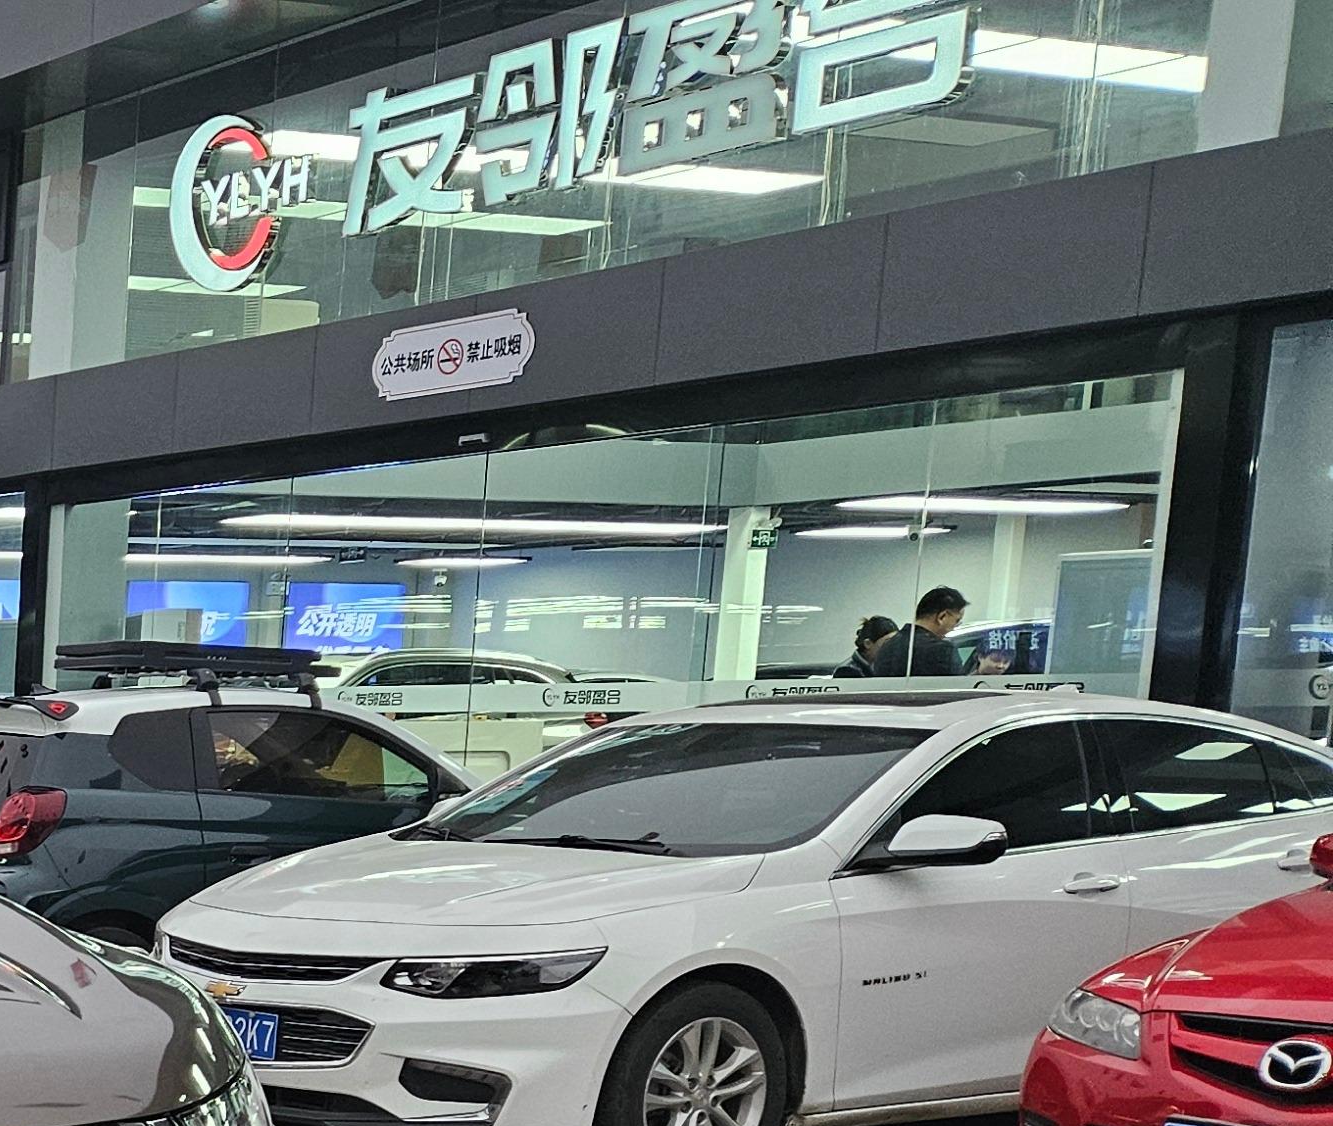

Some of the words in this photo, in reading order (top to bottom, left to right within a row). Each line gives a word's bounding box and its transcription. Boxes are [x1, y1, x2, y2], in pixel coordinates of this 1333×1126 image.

[201, 154, 313, 226] YLYH
[381, 348, 435, 376] 公共场所
[467, 334, 522, 363] 禁止吸烟
[297, 608, 377, 637] 公开透明
